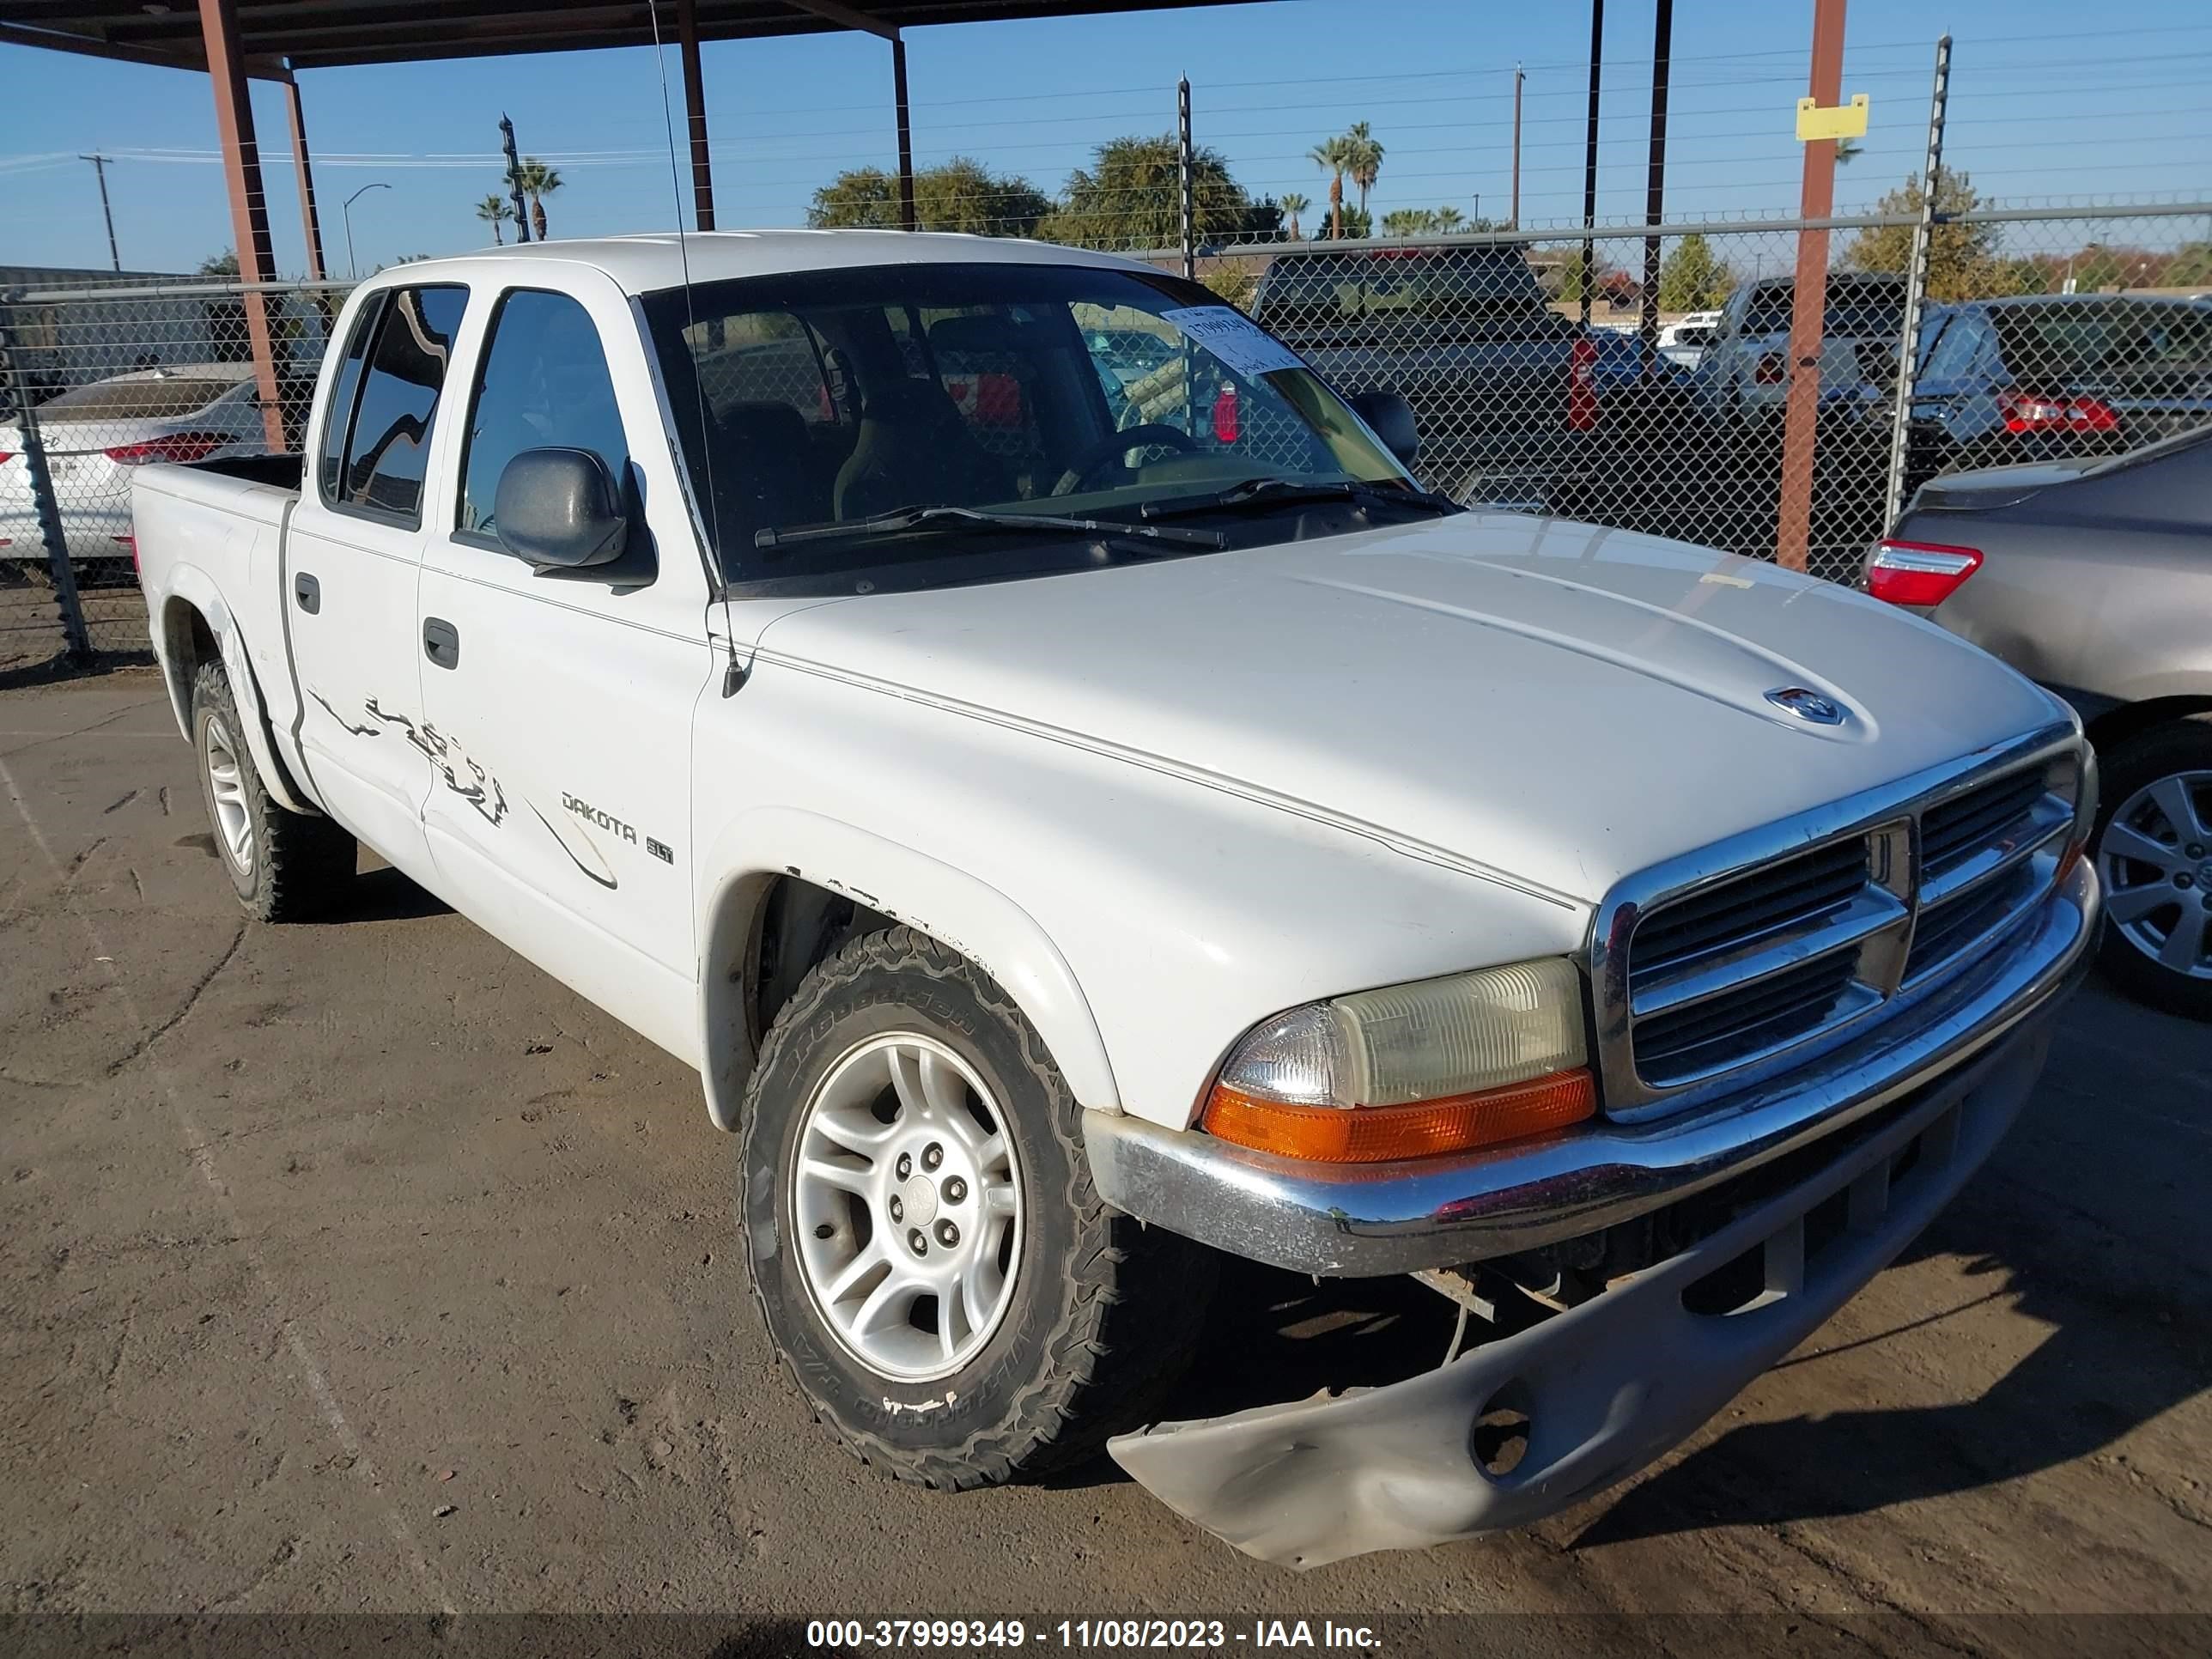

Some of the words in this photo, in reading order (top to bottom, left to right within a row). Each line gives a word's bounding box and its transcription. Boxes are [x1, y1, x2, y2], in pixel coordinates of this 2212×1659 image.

[1188, 318, 1250, 337] 37999349
[562, 791, 637, 845] DAKOTA
[647, 836, 673, 865] SLT
